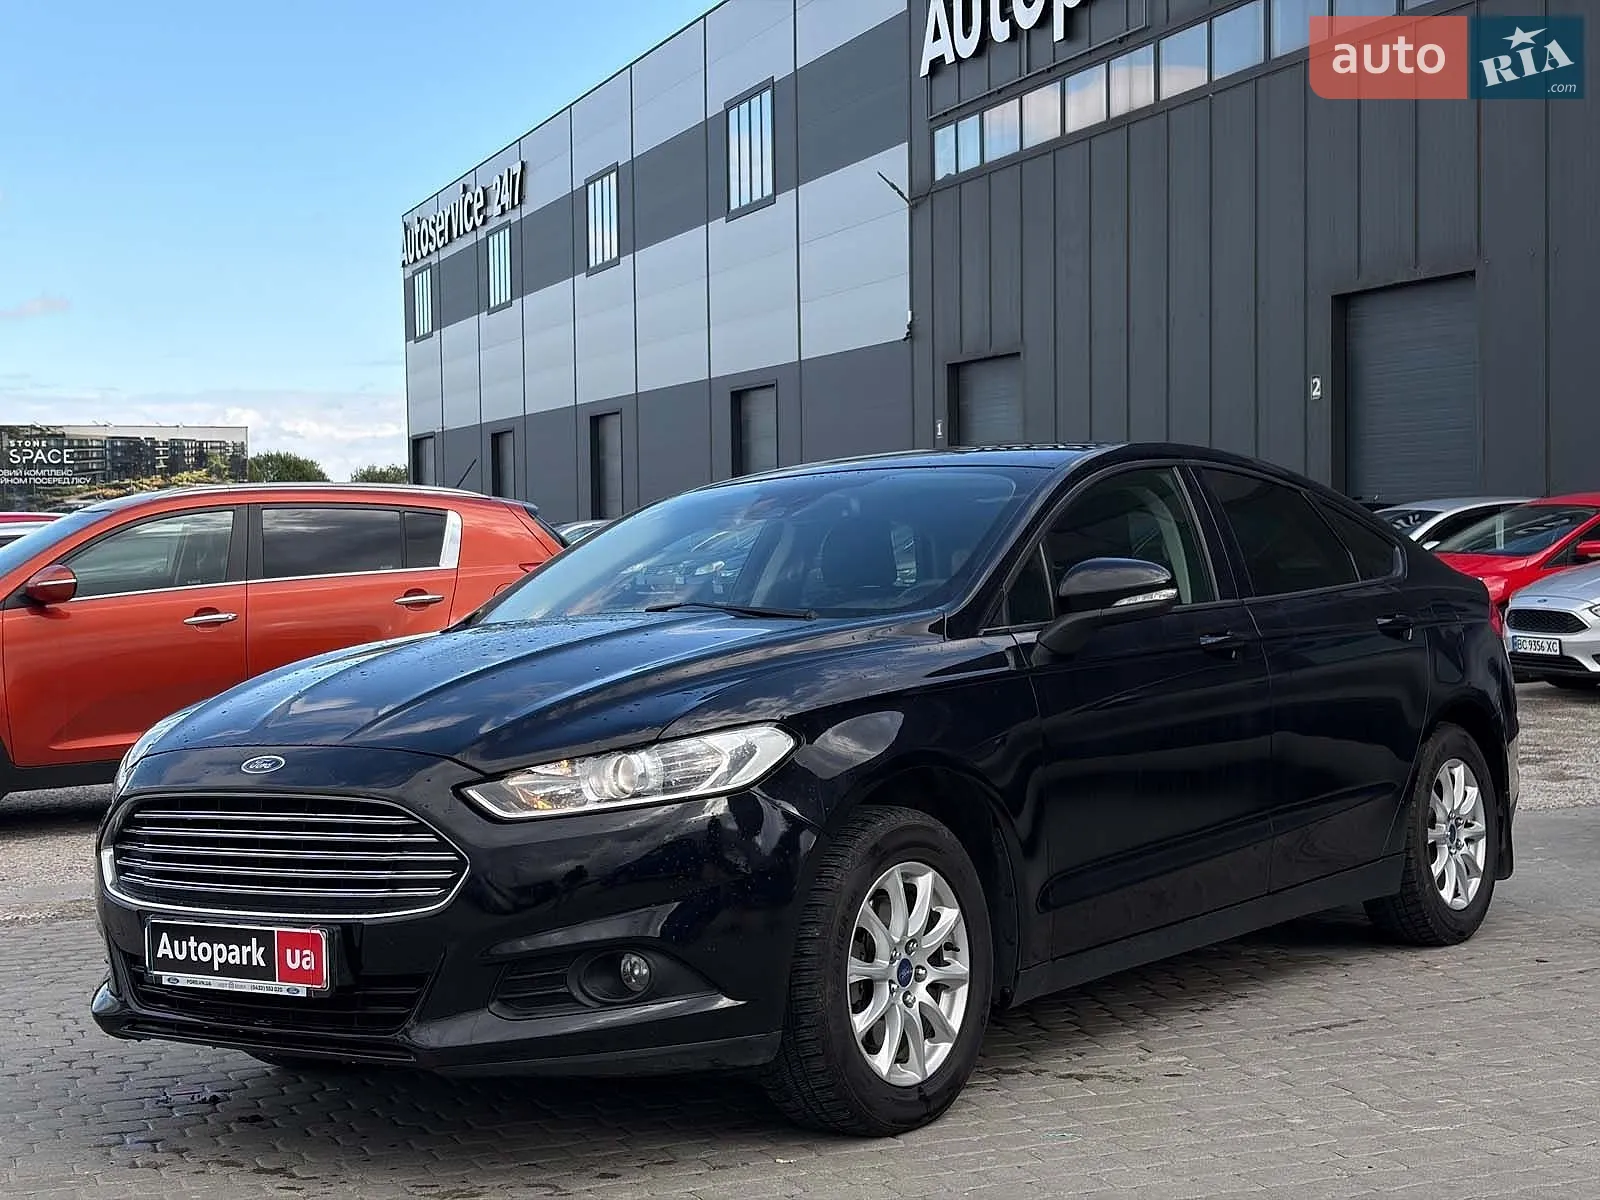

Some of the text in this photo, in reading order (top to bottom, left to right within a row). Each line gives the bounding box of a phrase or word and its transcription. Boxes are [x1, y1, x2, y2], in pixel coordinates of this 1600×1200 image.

[402, 183, 485, 266] Autoservice
[1312, 377, 1321, 396] 2
[9, 448, 75, 464] SPACE
[24, 469, 74, 477] КОМПЛЕКС
[28, 477, 70, 485] ПОСЕРЕД
[1517, 639, 1558, 653] BC 9356 XC
[157, 931, 315, 972] Autopark ua
